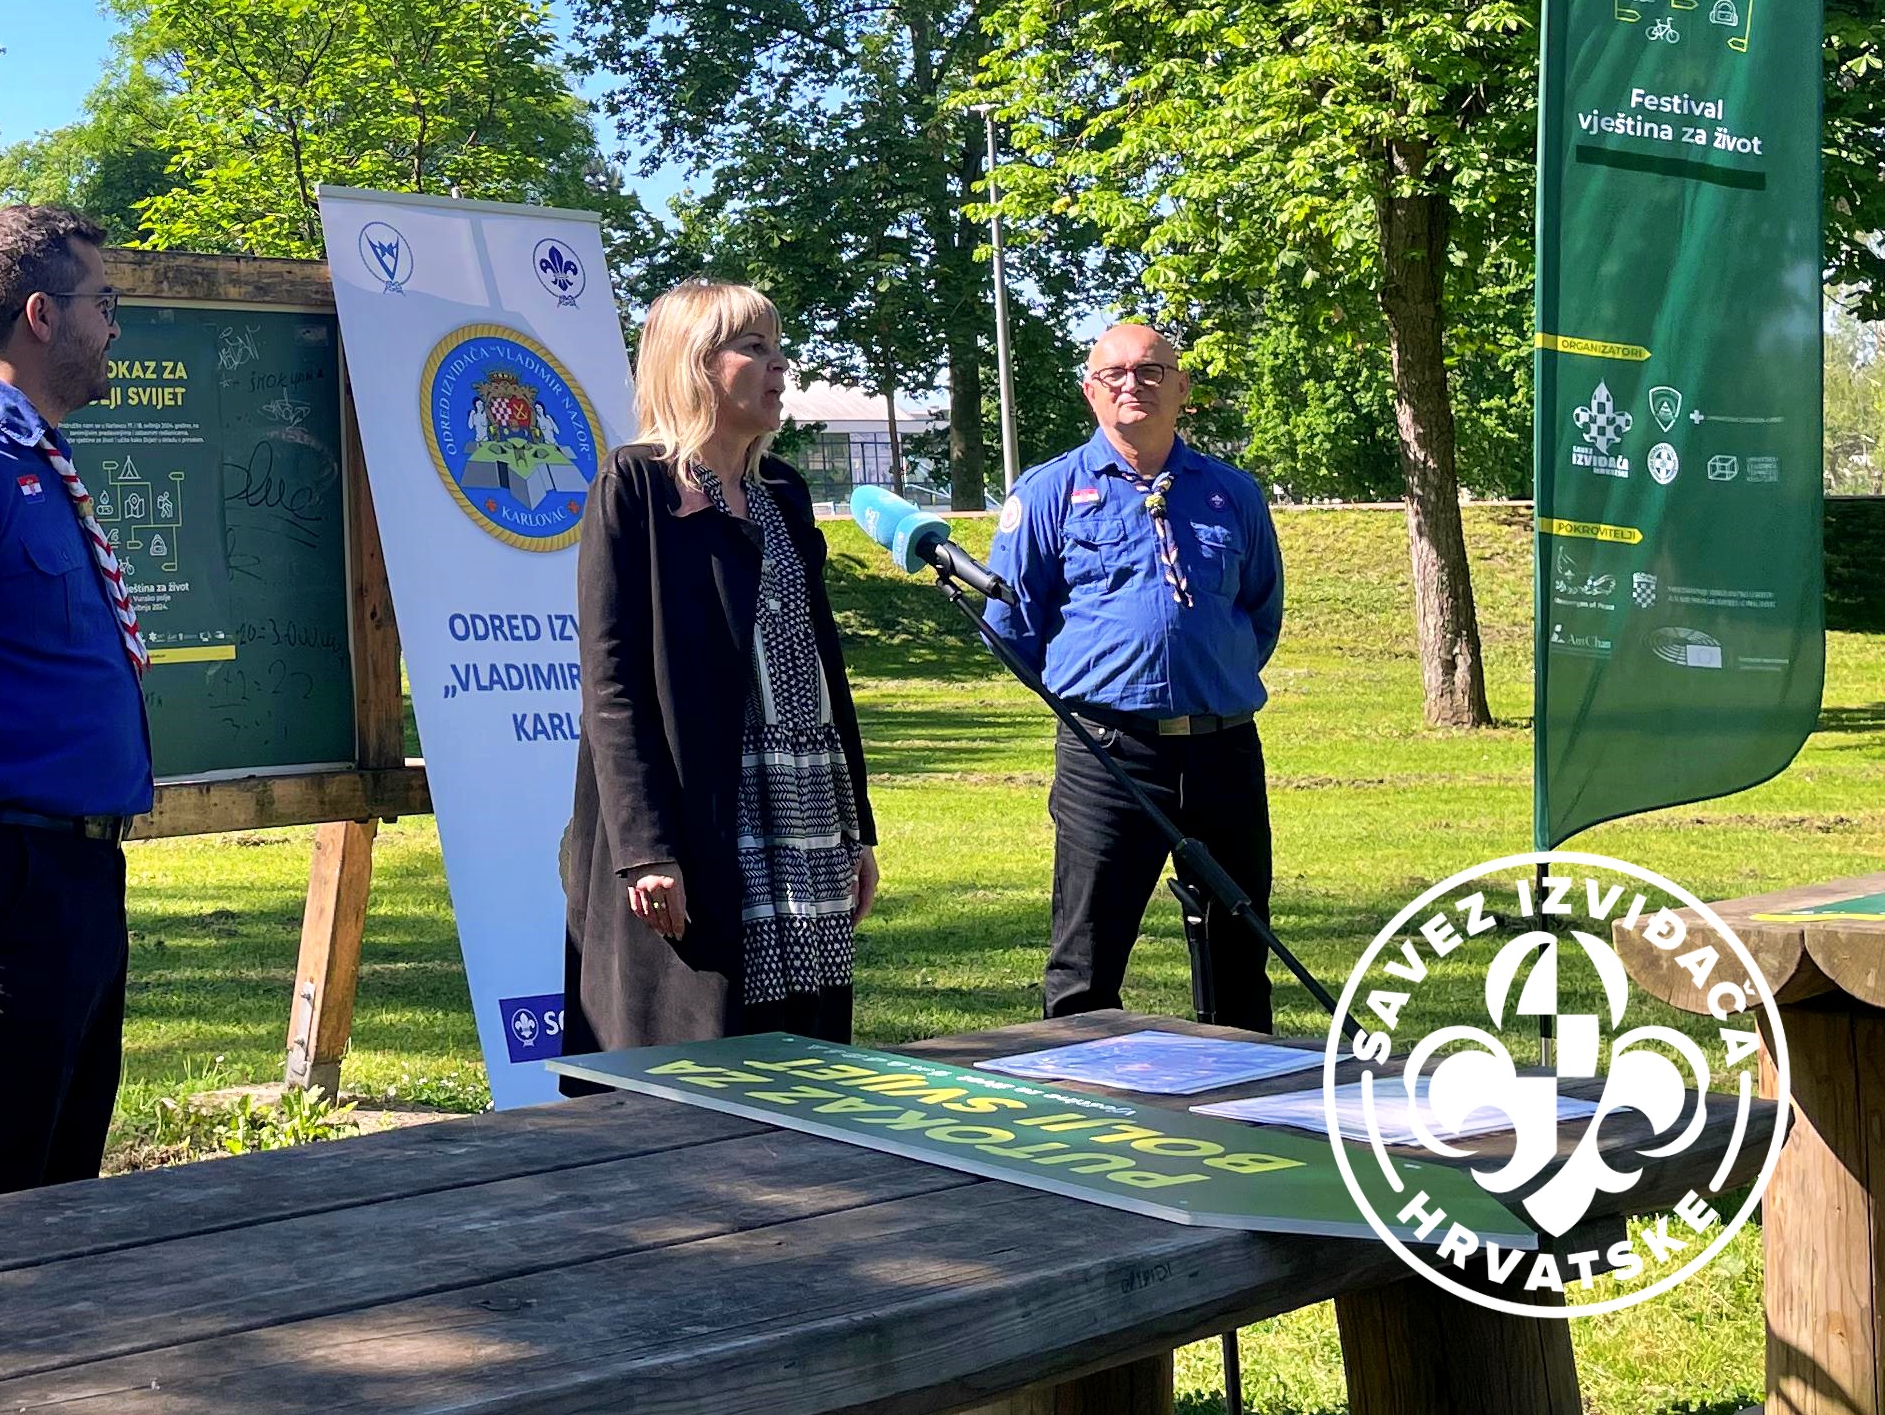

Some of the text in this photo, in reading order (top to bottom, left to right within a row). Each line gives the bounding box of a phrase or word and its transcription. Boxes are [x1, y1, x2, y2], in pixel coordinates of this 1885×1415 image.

[1630, 87, 1724, 120] Festival
[1577, 109, 1763, 155] vještina za život
[1561, 339, 1642, 358] ORGANIZATORI
[161, 361, 188, 380] ZA
[127, 387, 187, 410] SVIJET
[439, 396, 458, 456] ODRED
[501, 504, 568, 528] KARLOVAC
[1558, 522, 1636, 540] POKROVITELJI
[449, 613, 541, 641] ODRED
[512, 712, 581, 741] KARL
[644, 1058, 767, 1088] ZA
[741, 1057, 1028, 1114] SVIJET
[743, 1085, 1212, 1189] PUTOKAZ
[1012, 1111, 1309, 1175] BOLJI
